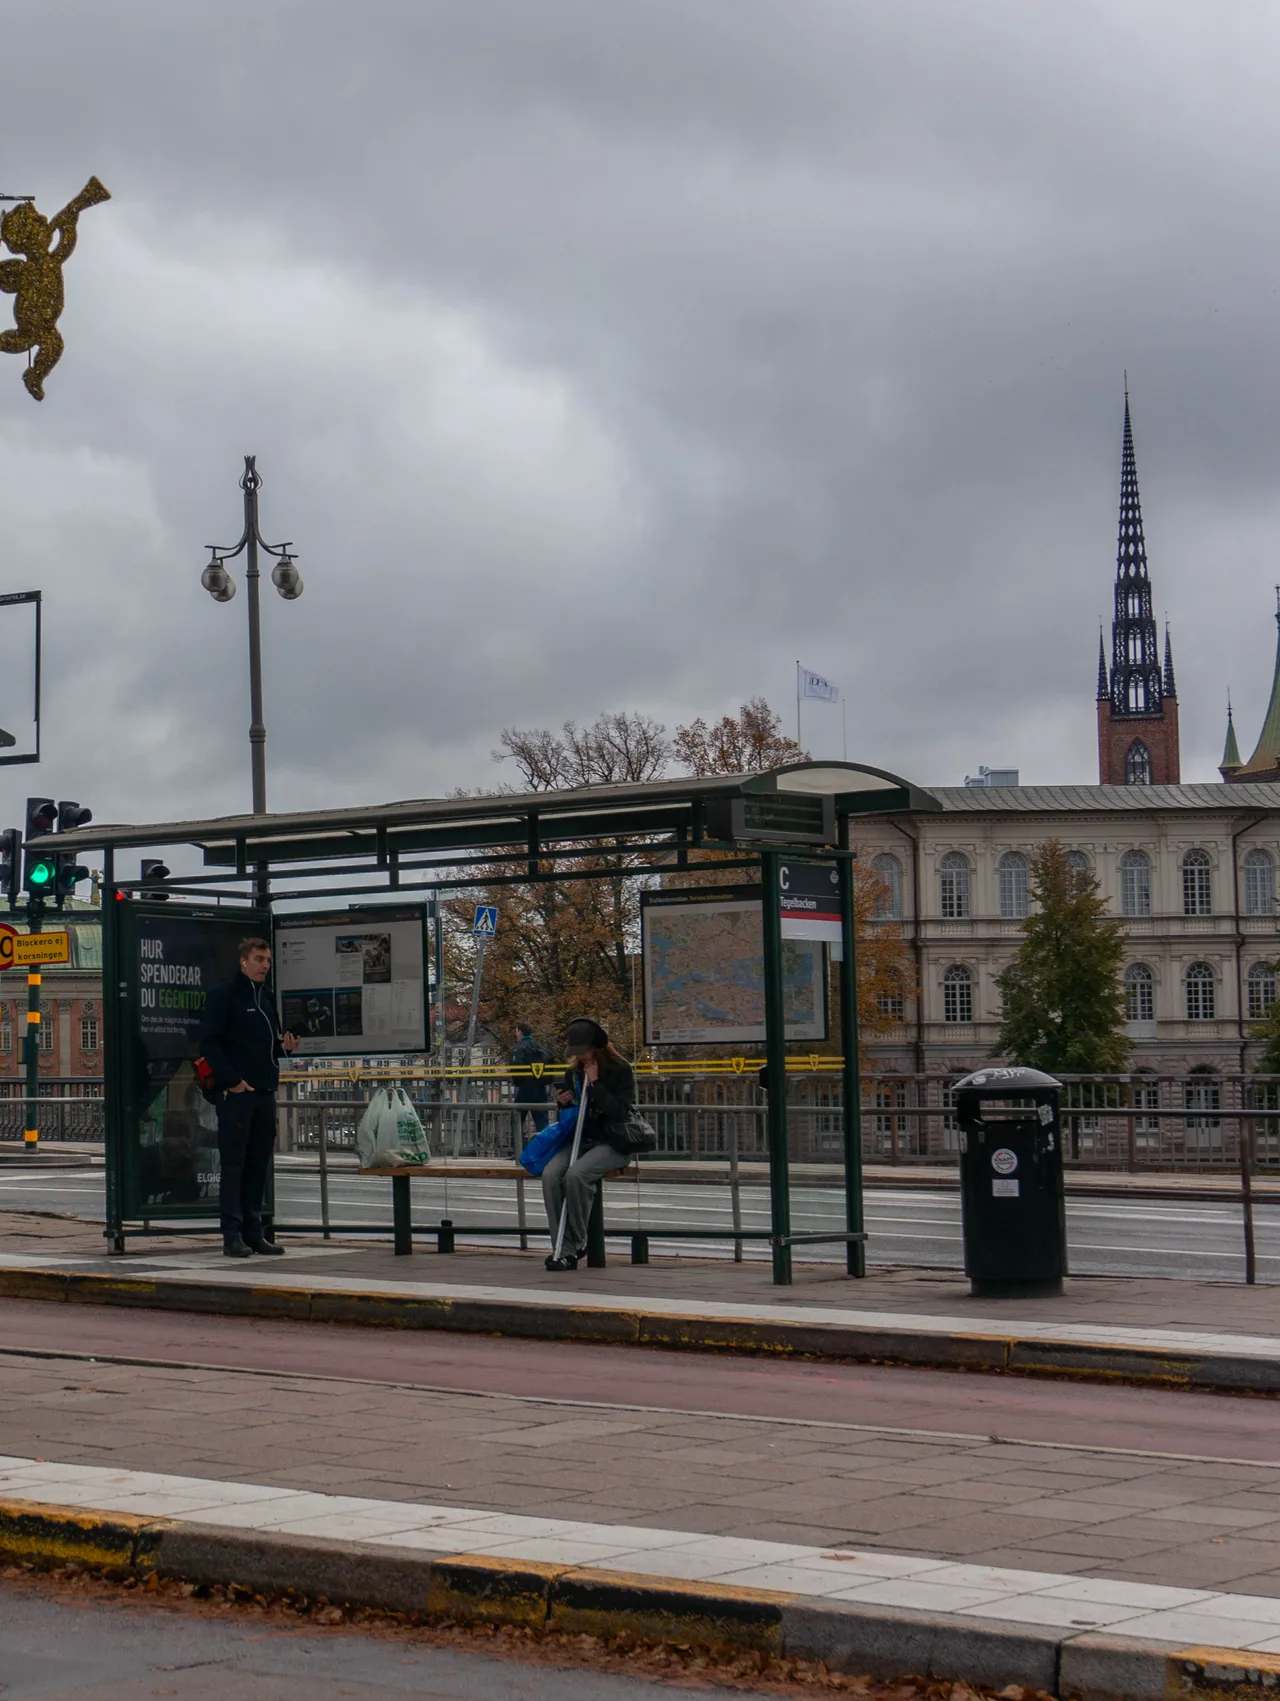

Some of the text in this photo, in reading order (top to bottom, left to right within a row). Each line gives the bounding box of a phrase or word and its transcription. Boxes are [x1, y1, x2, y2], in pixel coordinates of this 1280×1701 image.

[780, 866, 789, 889] C
[780, 896, 817, 909] Tegelbacken
[17, 936, 63, 947] Blockera ej
[140, 938, 163, 959] HUR
[18, 951, 63, 961] korsningen
[140, 963, 201, 986] SPENDERAR
[141, 988, 155, 1008] DU
